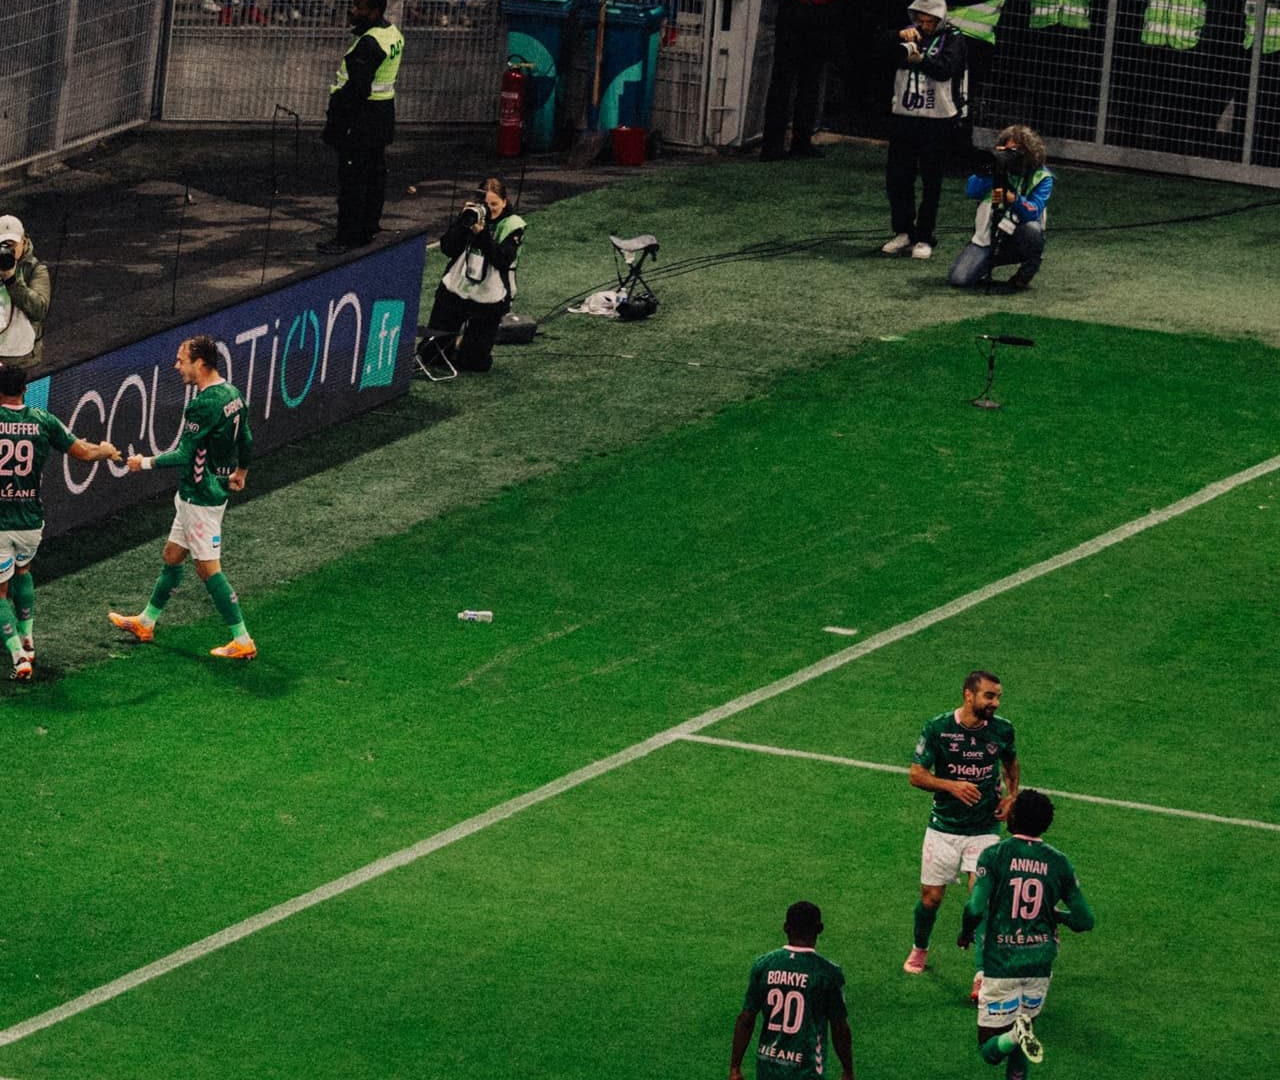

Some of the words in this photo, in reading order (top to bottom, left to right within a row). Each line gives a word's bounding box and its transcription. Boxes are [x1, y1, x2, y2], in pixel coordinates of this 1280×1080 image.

[1009, 857, 1049, 876] ANNAN
[1009, 877, 1044, 920] 19
[767, 970, 809, 989] BOAKYE
[767, 987, 806, 1035] 20
